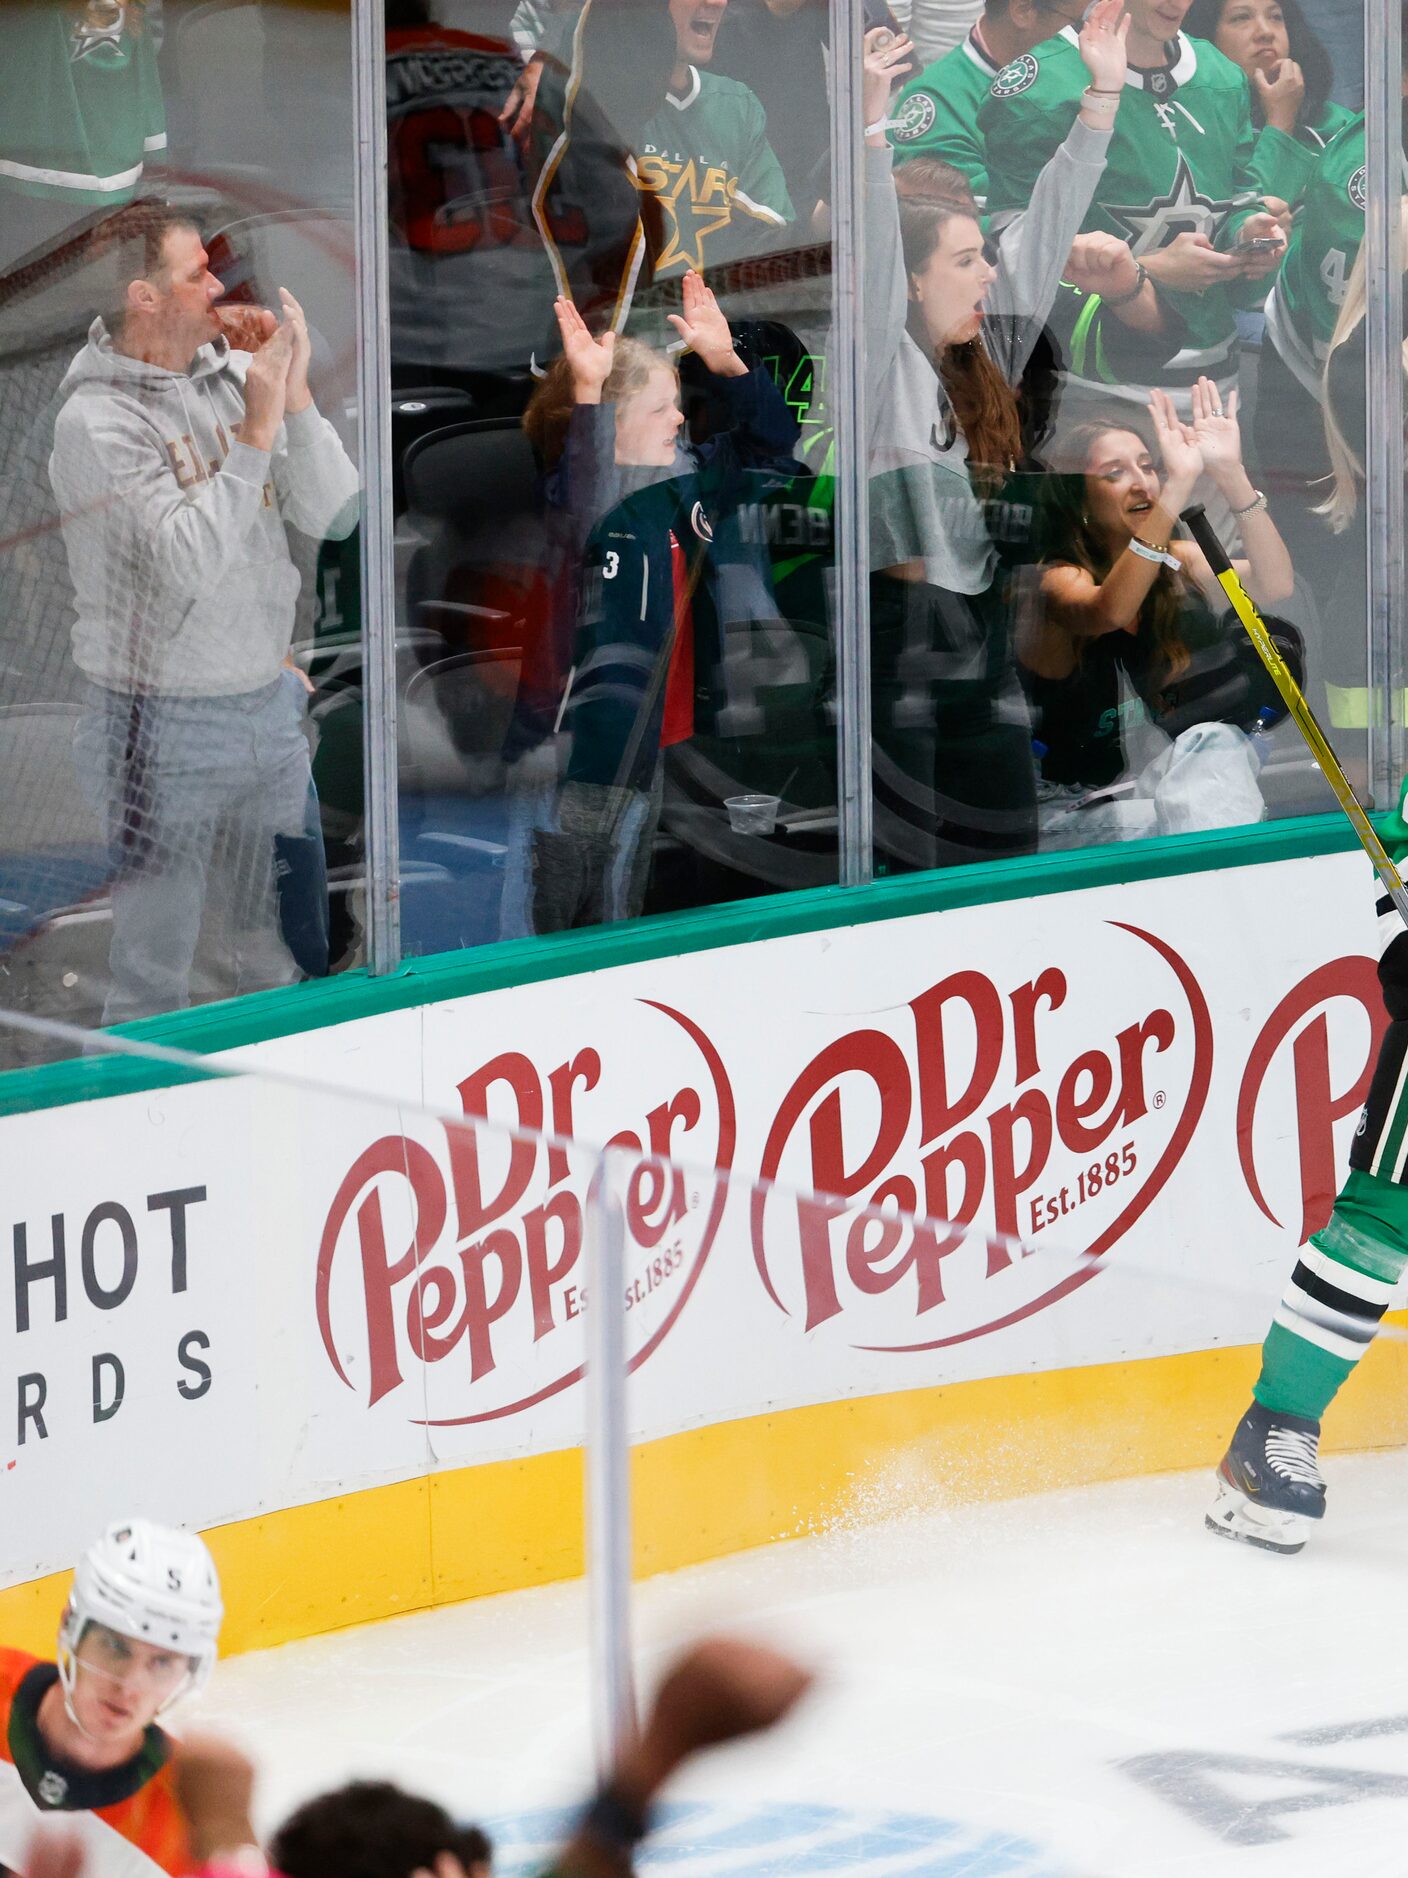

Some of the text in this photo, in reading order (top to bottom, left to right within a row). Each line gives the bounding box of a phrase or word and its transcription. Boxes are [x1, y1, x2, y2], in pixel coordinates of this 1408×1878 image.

[602, 550, 620, 580] 3
[1250, 626, 1283, 678] HYPERLITE
[908, 966, 1067, 1148] Dr
[440, 1047, 601, 1242] Dr
[750, 1008, 1175, 1333] Pepper
[1030, 1140, 1138, 1235] Est.1885
[13, 1185, 208, 1333] HOT
[316, 1087, 701, 1409] Pepper
